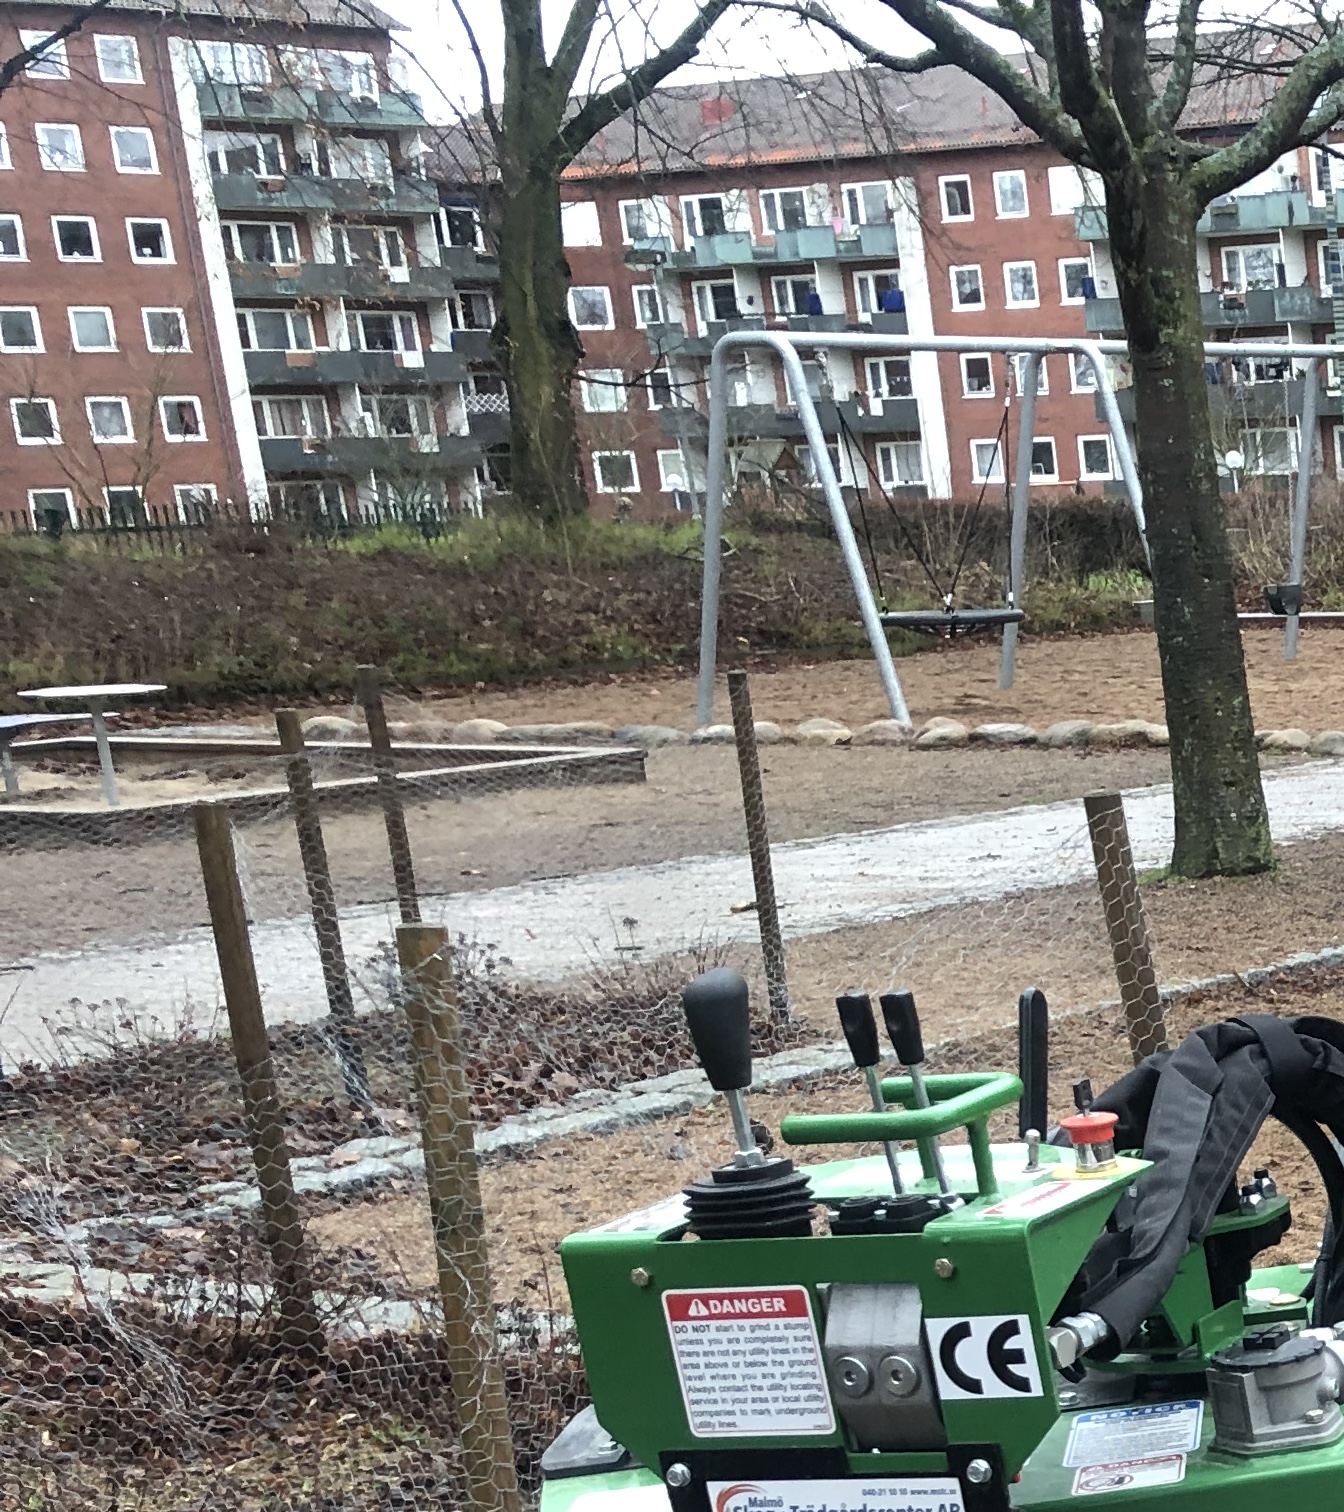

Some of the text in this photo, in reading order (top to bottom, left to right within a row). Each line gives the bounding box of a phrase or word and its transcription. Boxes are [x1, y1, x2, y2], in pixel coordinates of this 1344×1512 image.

[709, 1298, 787, 1313] DANGER
[674, 1325, 688, 1334] DO
[692, 1325, 711, 1333] NOT
[940, 1319, 1032, 1394] CE
[748, 1495, 784, 1508] Malmö
